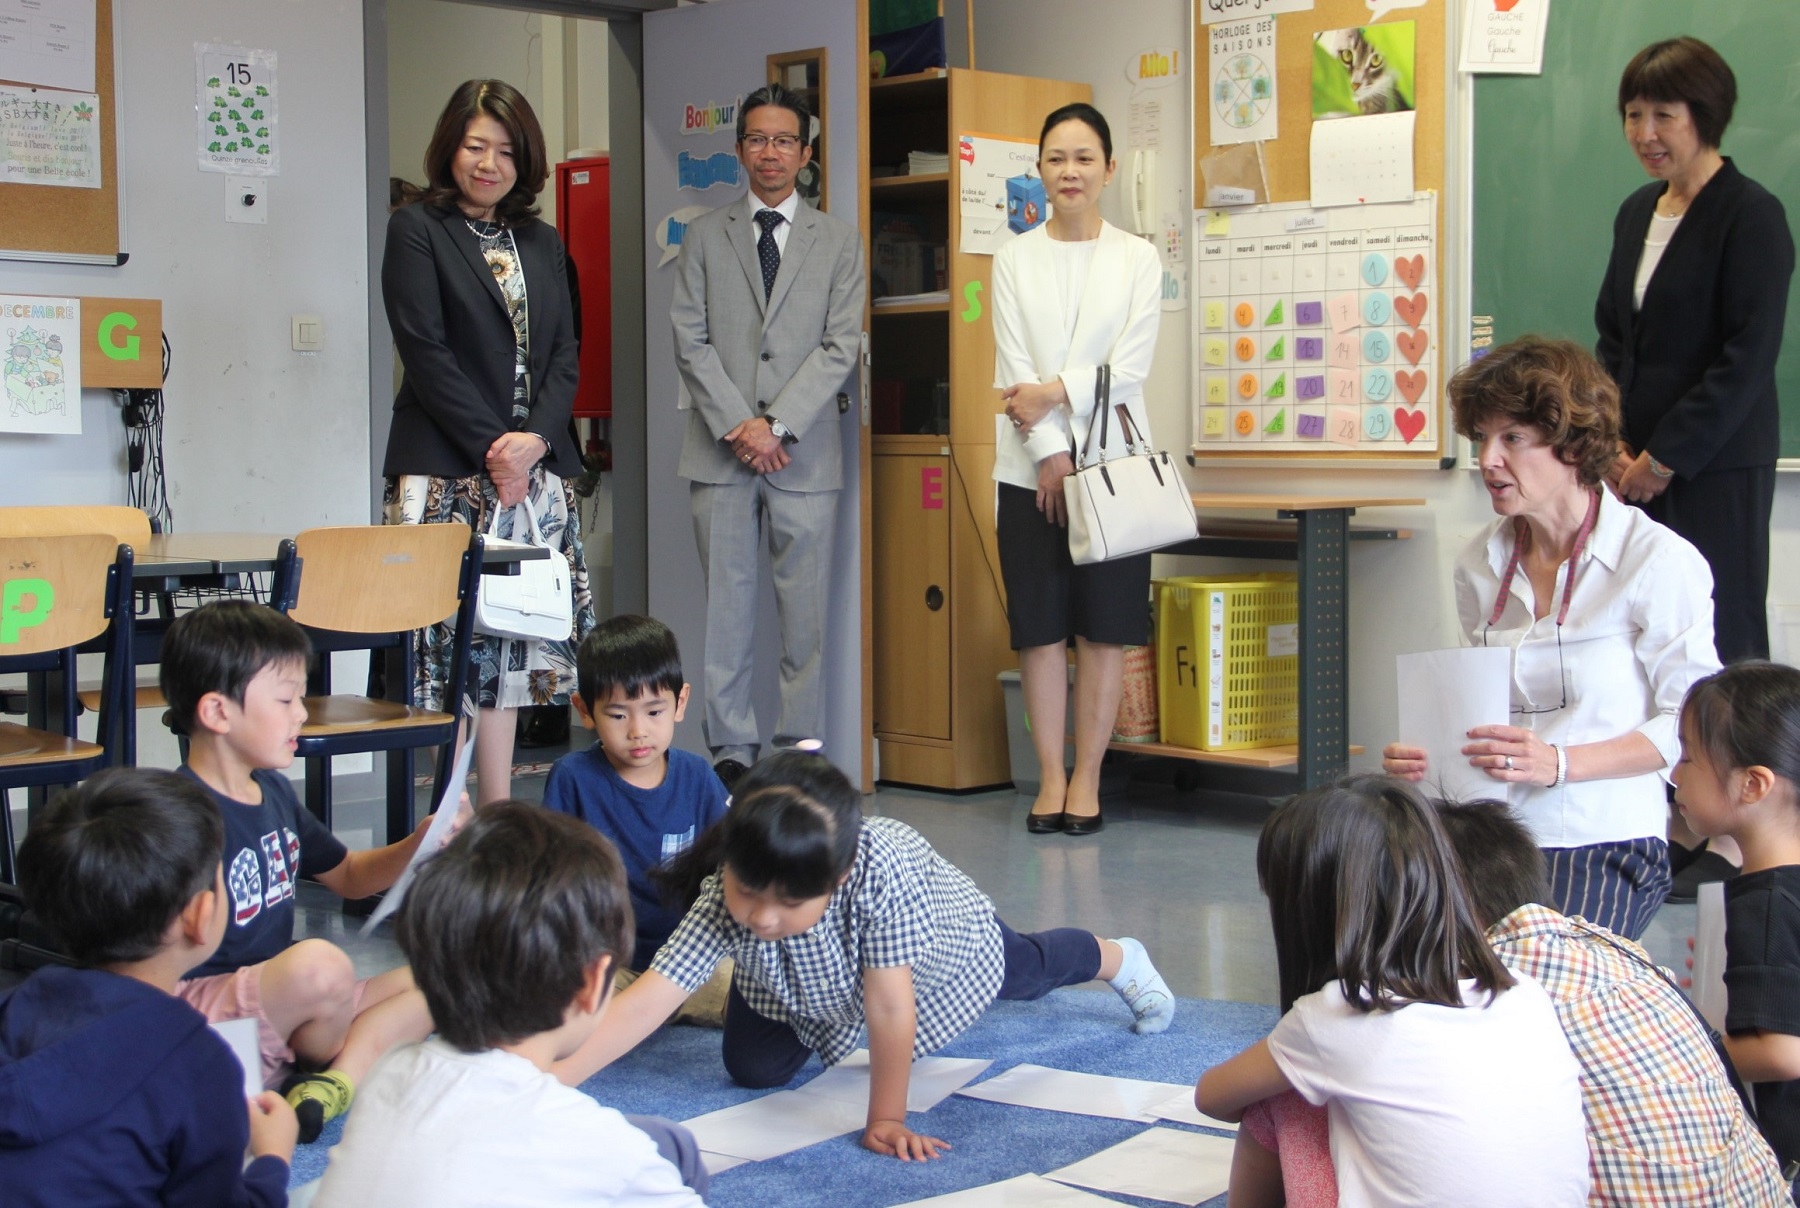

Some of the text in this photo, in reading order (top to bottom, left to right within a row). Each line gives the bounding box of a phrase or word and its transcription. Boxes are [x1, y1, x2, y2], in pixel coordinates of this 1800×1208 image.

[1488, 12, 1525, 22] GAUCHE
[1214, 21, 1272, 40] HORLOGE DES
[1487, 28, 1521, 36] Gauche
[226, 62, 252, 86] 15
[686, 102, 734, 132] Bonjour
[8, 165, 25, 173] pour
[44, 166, 64, 175] Belle
[1218, 192, 1244, 201] janvier
[1294, 218, 1314, 227] juillet
[1237, 244, 1255, 252] mardi
[1264, 242, 1291, 251] mercredi
[1302, 240, 1318, 250] jeudi
[1329, 237, 1358, 246] vendredi
[1366, 236, 1390, 244] samedi
[1396, 233, 1429, 243] dimanche
[1160, 271, 1178, 300] llo
[0, 304, 74, 319] ECEMBRE
[961, 280, 983, 323] S
[1239, 311, 1245, 321] 4
[1272, 308, 1279, 319] 5
[1303, 307, 1310, 320] 6
[1371, 301, 1380, 320] 8
[98, 311, 140, 361] G
[1239, 343, 1249, 356] 11
[1272, 343, 1282, 356] 12
[1303, 340, 1314, 355] 13
[1336, 342, 1350, 357] 14
[1370, 340, 1382, 358] 15
[1243, 380, 1251, 391] 18
[1273, 382, 1283, 394] 19
[1302, 383, 1317, 396] 20
[1339, 380, 1354, 398] 21
[1368, 375, 1386, 396] 22
[1238, 416, 1248, 429] 25
[1272, 417, 1282, 431] 26
[1302, 416, 1318, 430] 27
[1338, 420, 1354, 438] 28
[1369, 413, 1385, 434] 29
[922, 467, 943, 509] E
[0, 578, 54, 644] P
